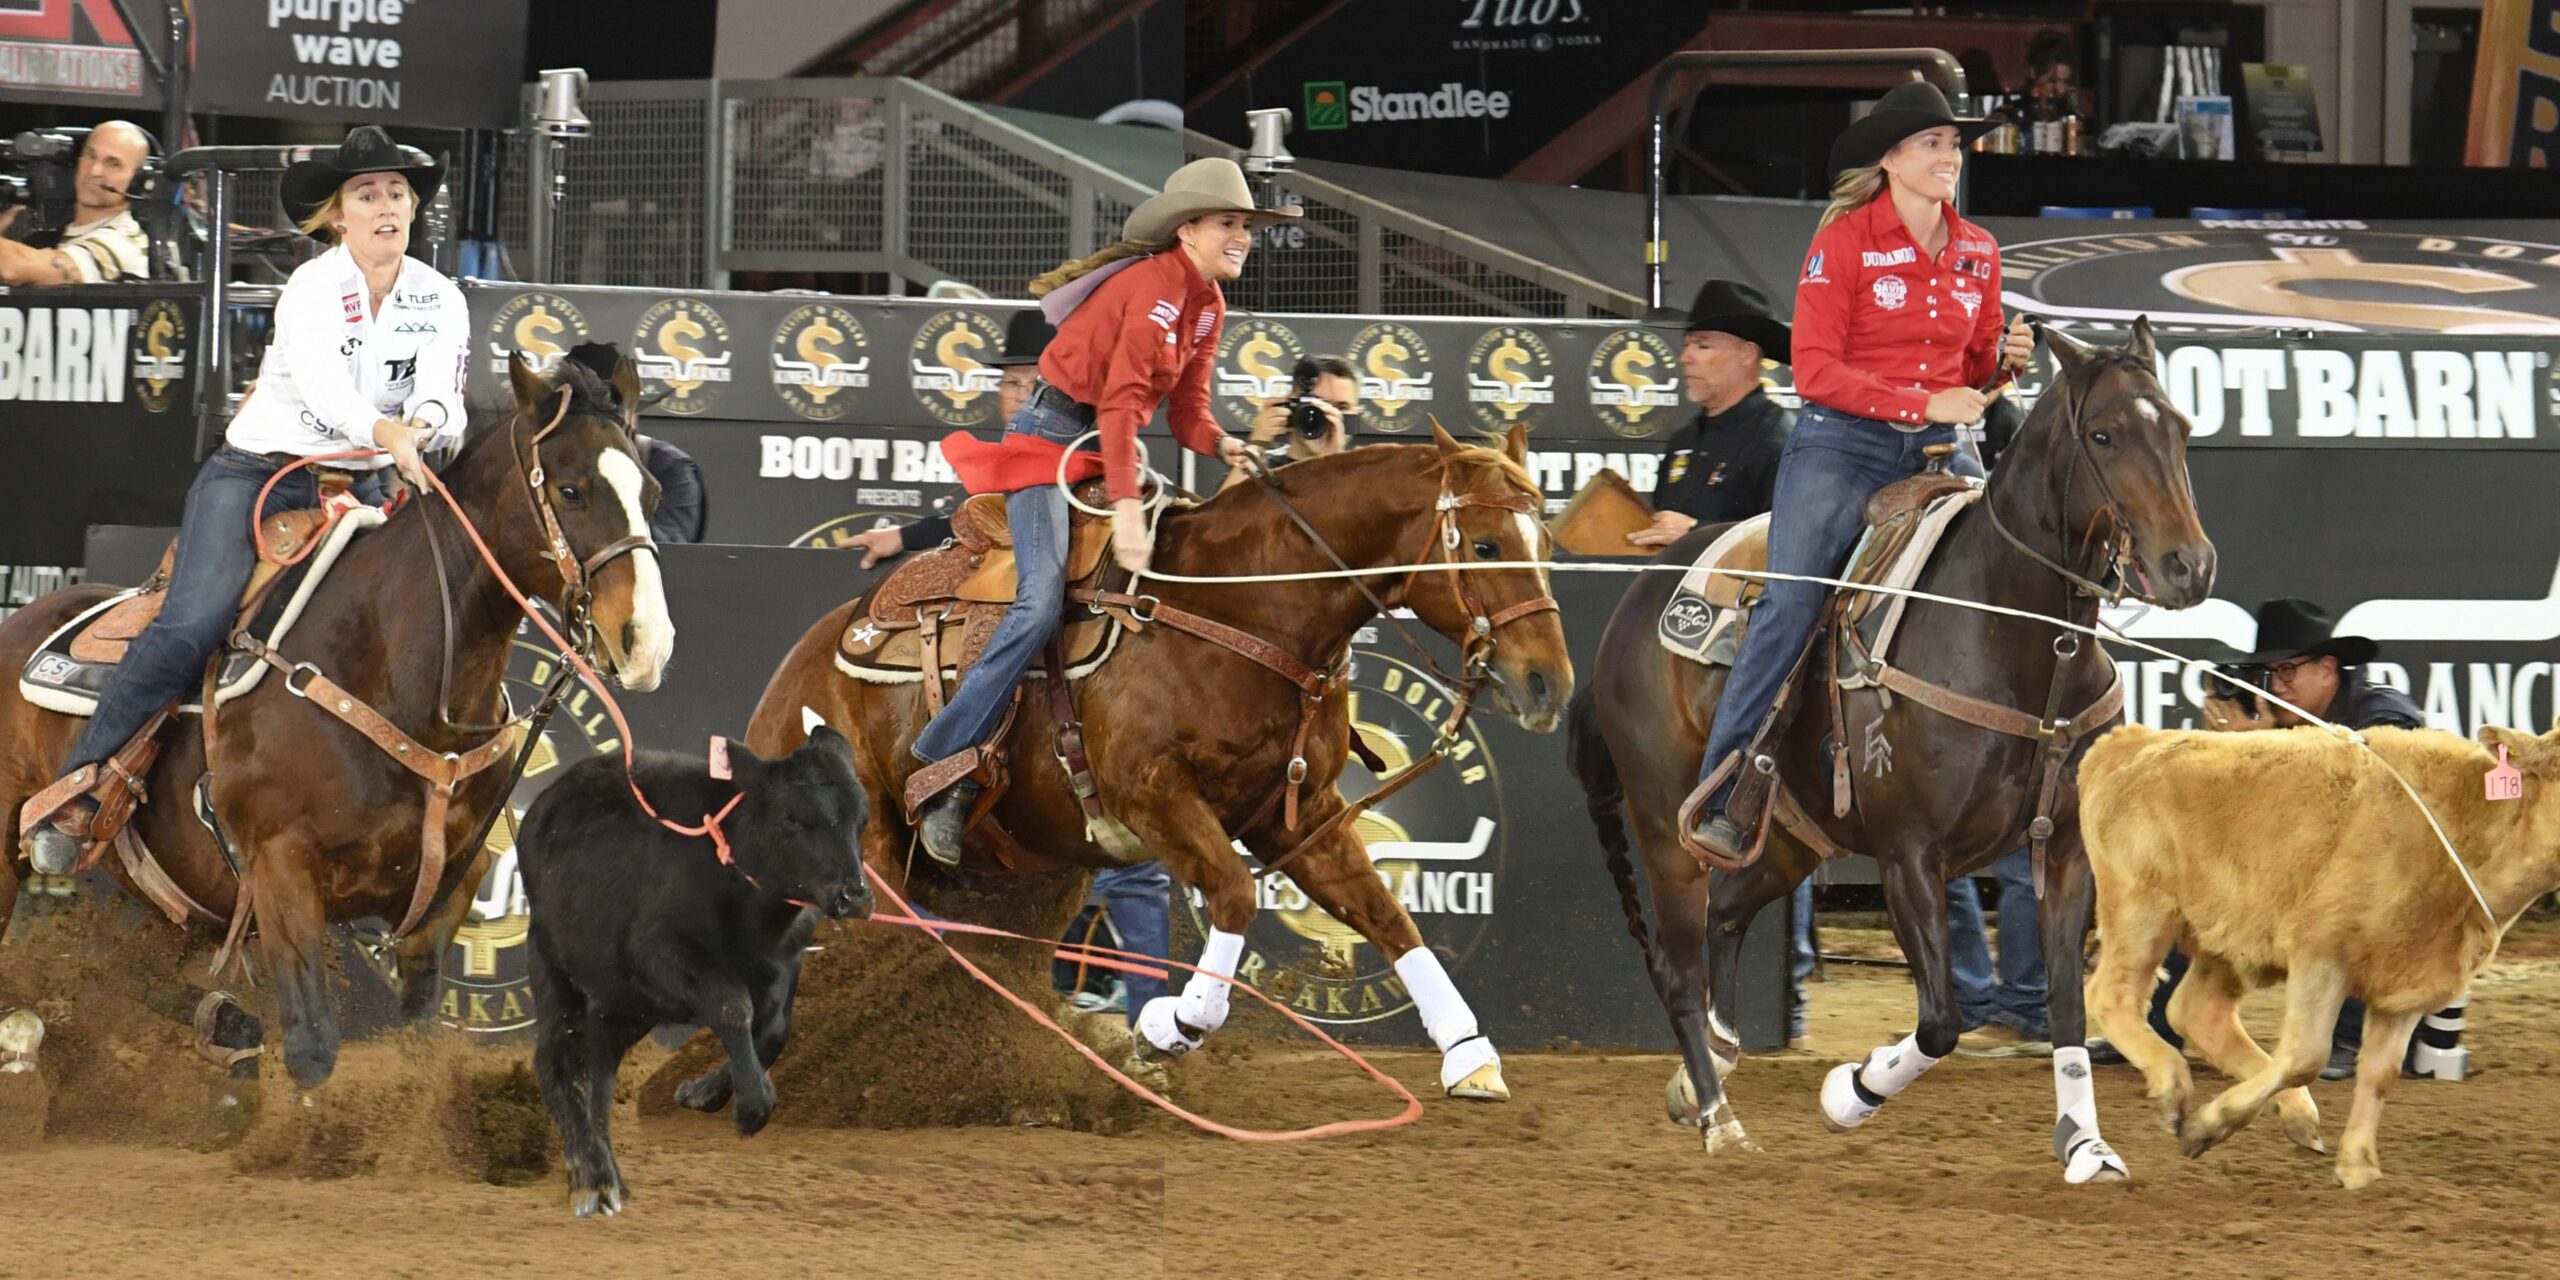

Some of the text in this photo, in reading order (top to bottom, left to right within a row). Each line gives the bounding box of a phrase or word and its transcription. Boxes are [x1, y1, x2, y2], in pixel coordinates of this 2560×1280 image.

[292, 33, 402, 68] wave
[1452, 35, 1602, 50] HANDMADE VODKA
[266, 73, 401, 110] AUCTION
[1351, 83, 1510, 122] Standlee
[1862, 247, 1916, 267] DURANGO
[0, 306, 130, 403] BARN
[2292, 350, 2537, 439] BARN
[760, 435, 965, 483] BOOT BA
[1574, 452, 1667, 492] BAR
[857, 488, 922, 507] PRESENTS
[39, 657, 75, 677] CSI
[2491, 776, 2520, 797] 178
